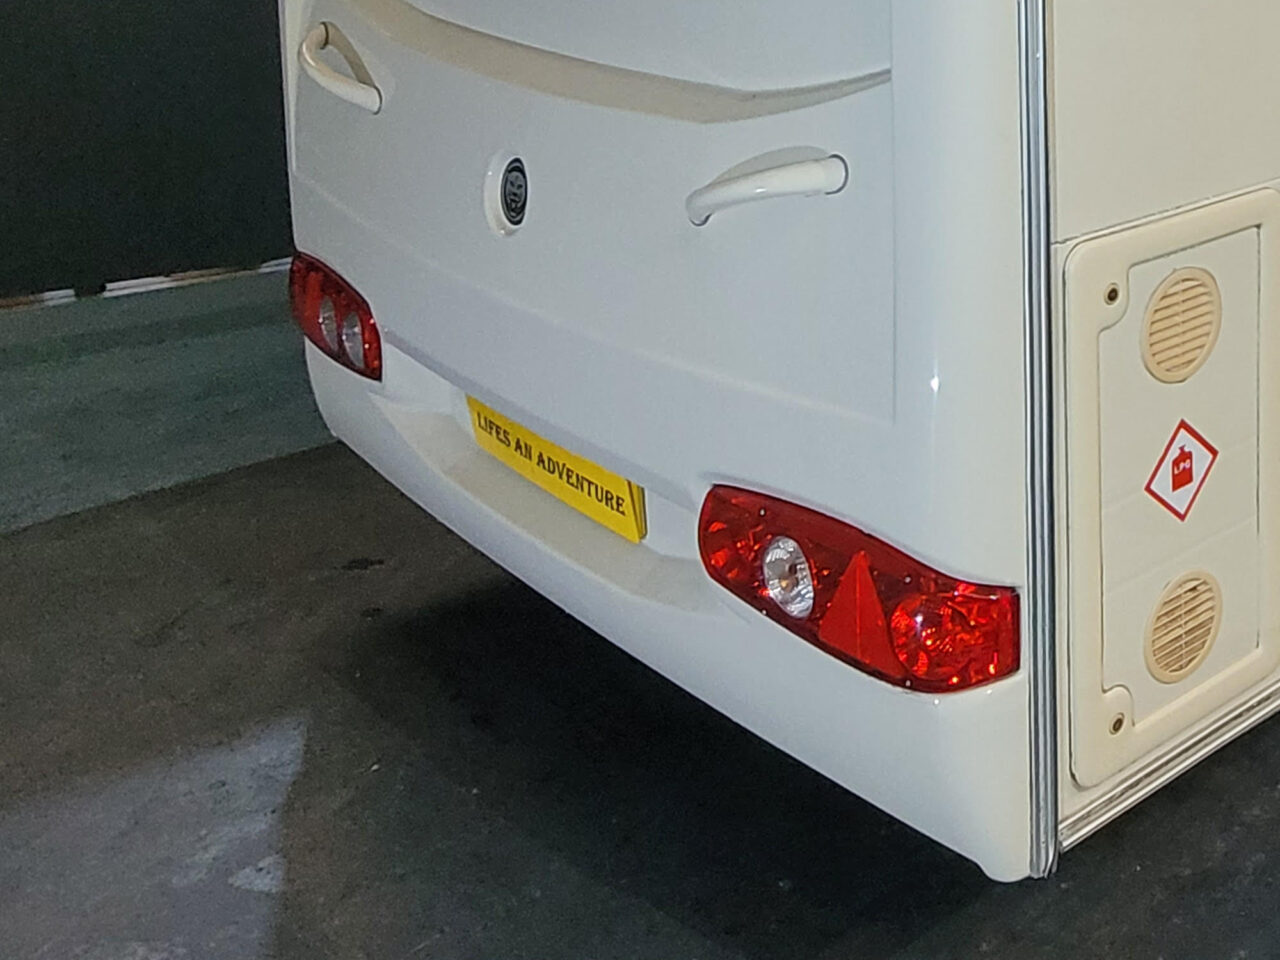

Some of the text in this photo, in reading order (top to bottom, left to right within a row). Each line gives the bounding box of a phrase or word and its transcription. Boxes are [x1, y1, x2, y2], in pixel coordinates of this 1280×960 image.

[477, 411, 626, 516] LIFES AN ADVENTURE
[1173, 458, 1191, 475] LPG
